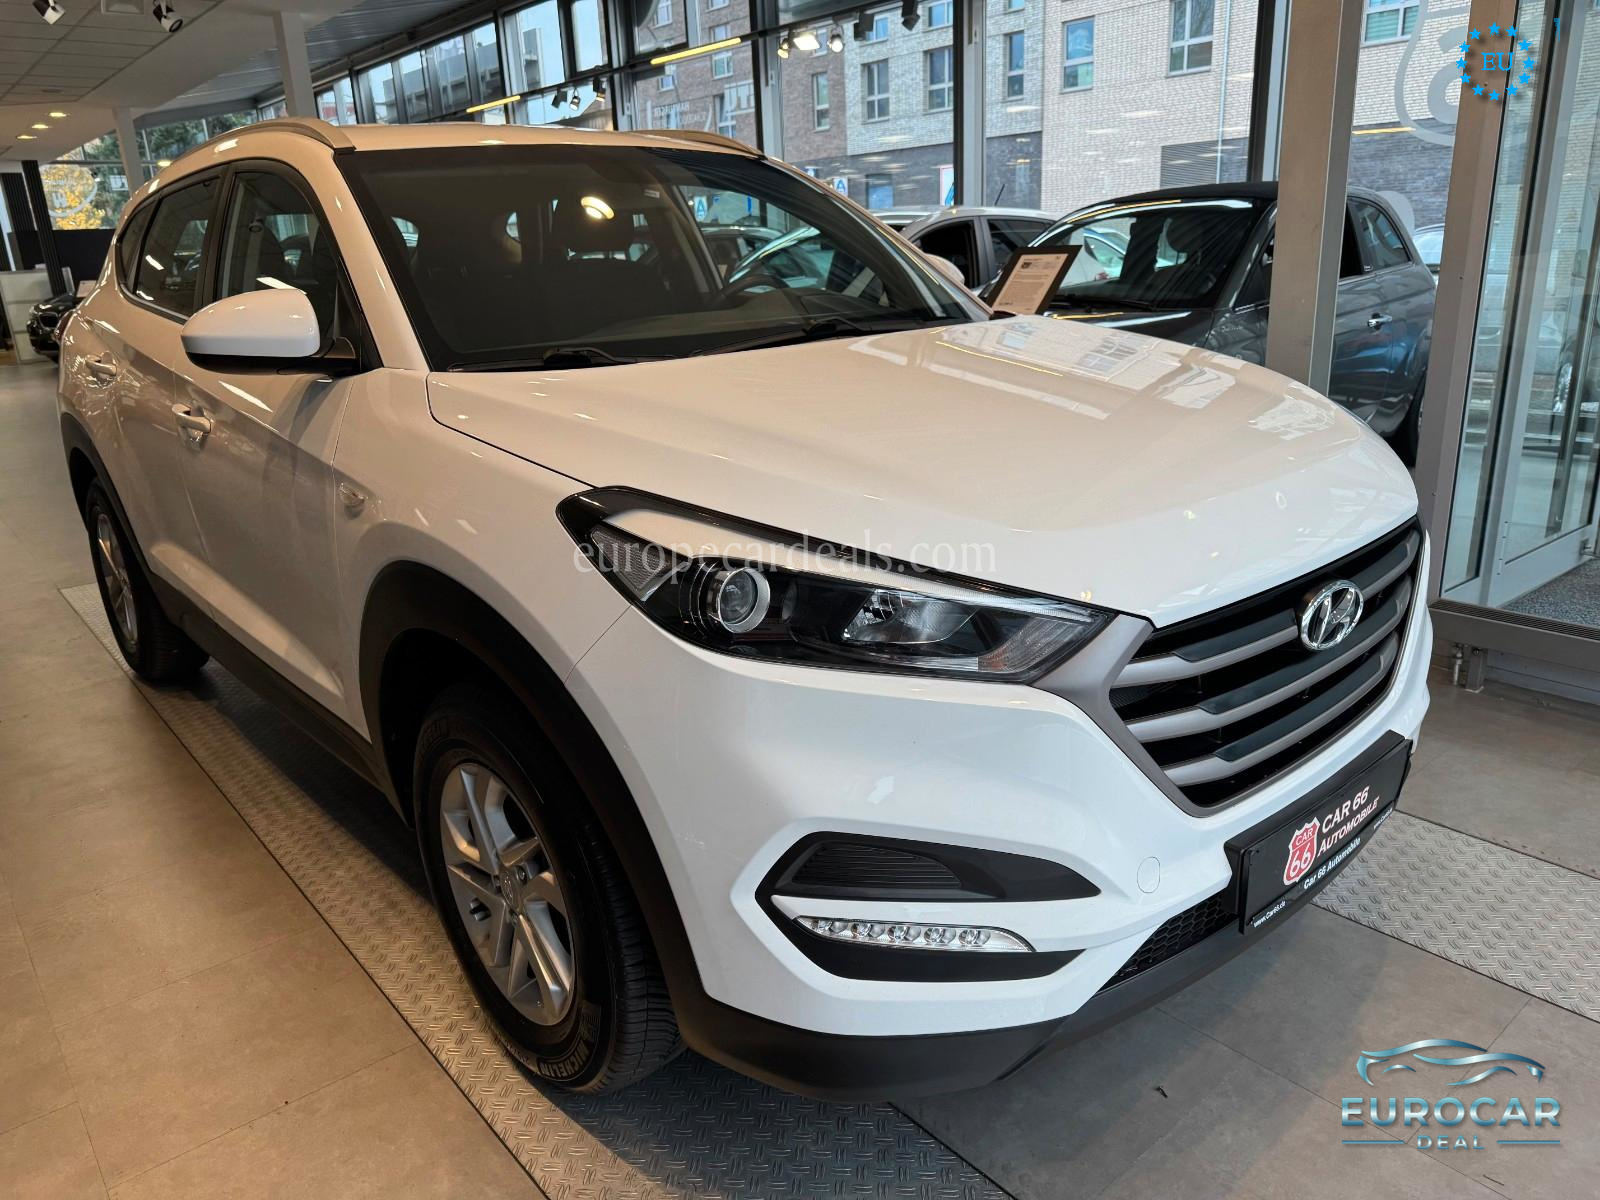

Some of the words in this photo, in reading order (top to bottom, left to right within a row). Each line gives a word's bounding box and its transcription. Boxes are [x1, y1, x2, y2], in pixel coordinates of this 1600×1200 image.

[1317, 796, 1380, 858] AUTOMOBILE
[1322, 800, 1351, 834] CAR
[1352, 785, 1370, 811] 66
[1295, 827, 1314, 846] CAR
[1289, 842, 1311, 878] 66
[1303, 874, 1317, 889] Car
[1317, 865, 1327, 879] 66
[1326, 836, 1361, 872] Automobile
[538, 1040, 590, 1078] MICHELIN
